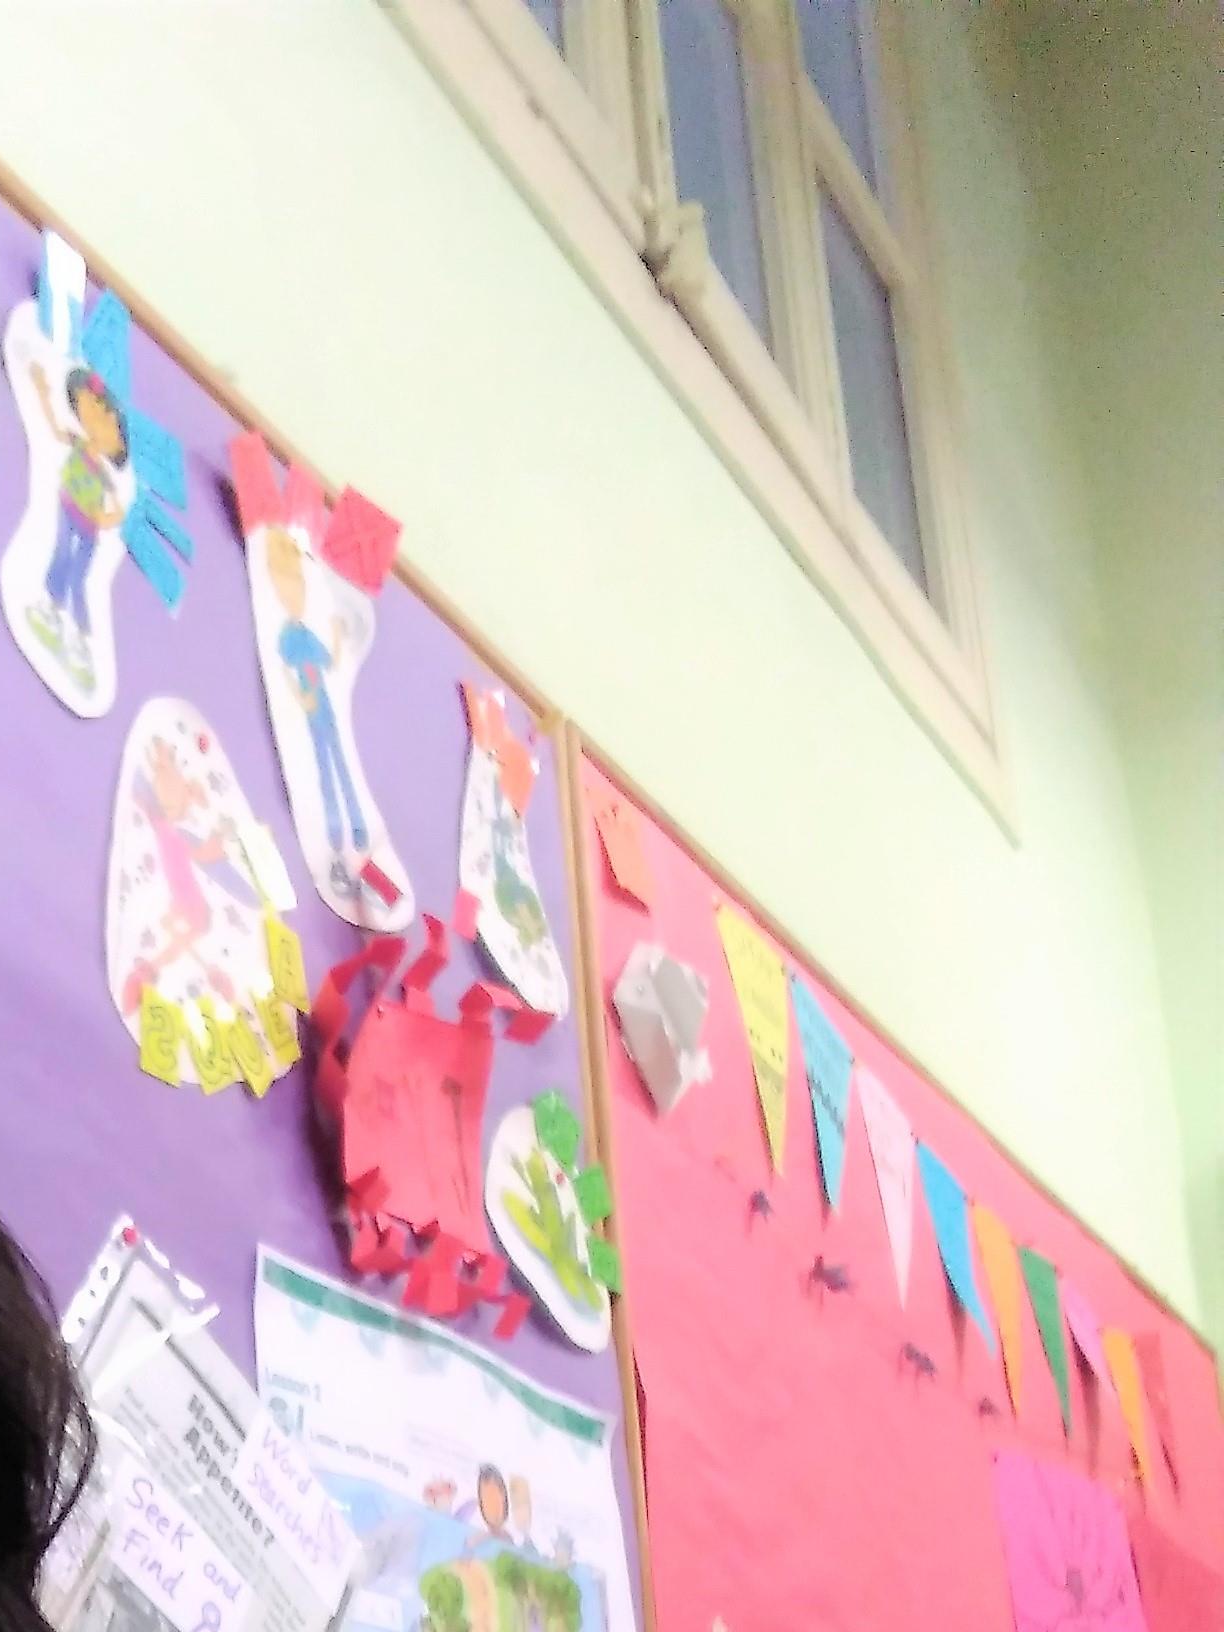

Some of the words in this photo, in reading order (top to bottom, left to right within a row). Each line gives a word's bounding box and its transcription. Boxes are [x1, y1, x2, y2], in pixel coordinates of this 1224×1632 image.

[184, 1427, 276, 1550] Appetite?
[261, 1427, 314, 1496] Word
[122, 1526, 186, 1601] Find
[125, 1475, 194, 1553] Seek
[202, 1560, 244, 1604] and
